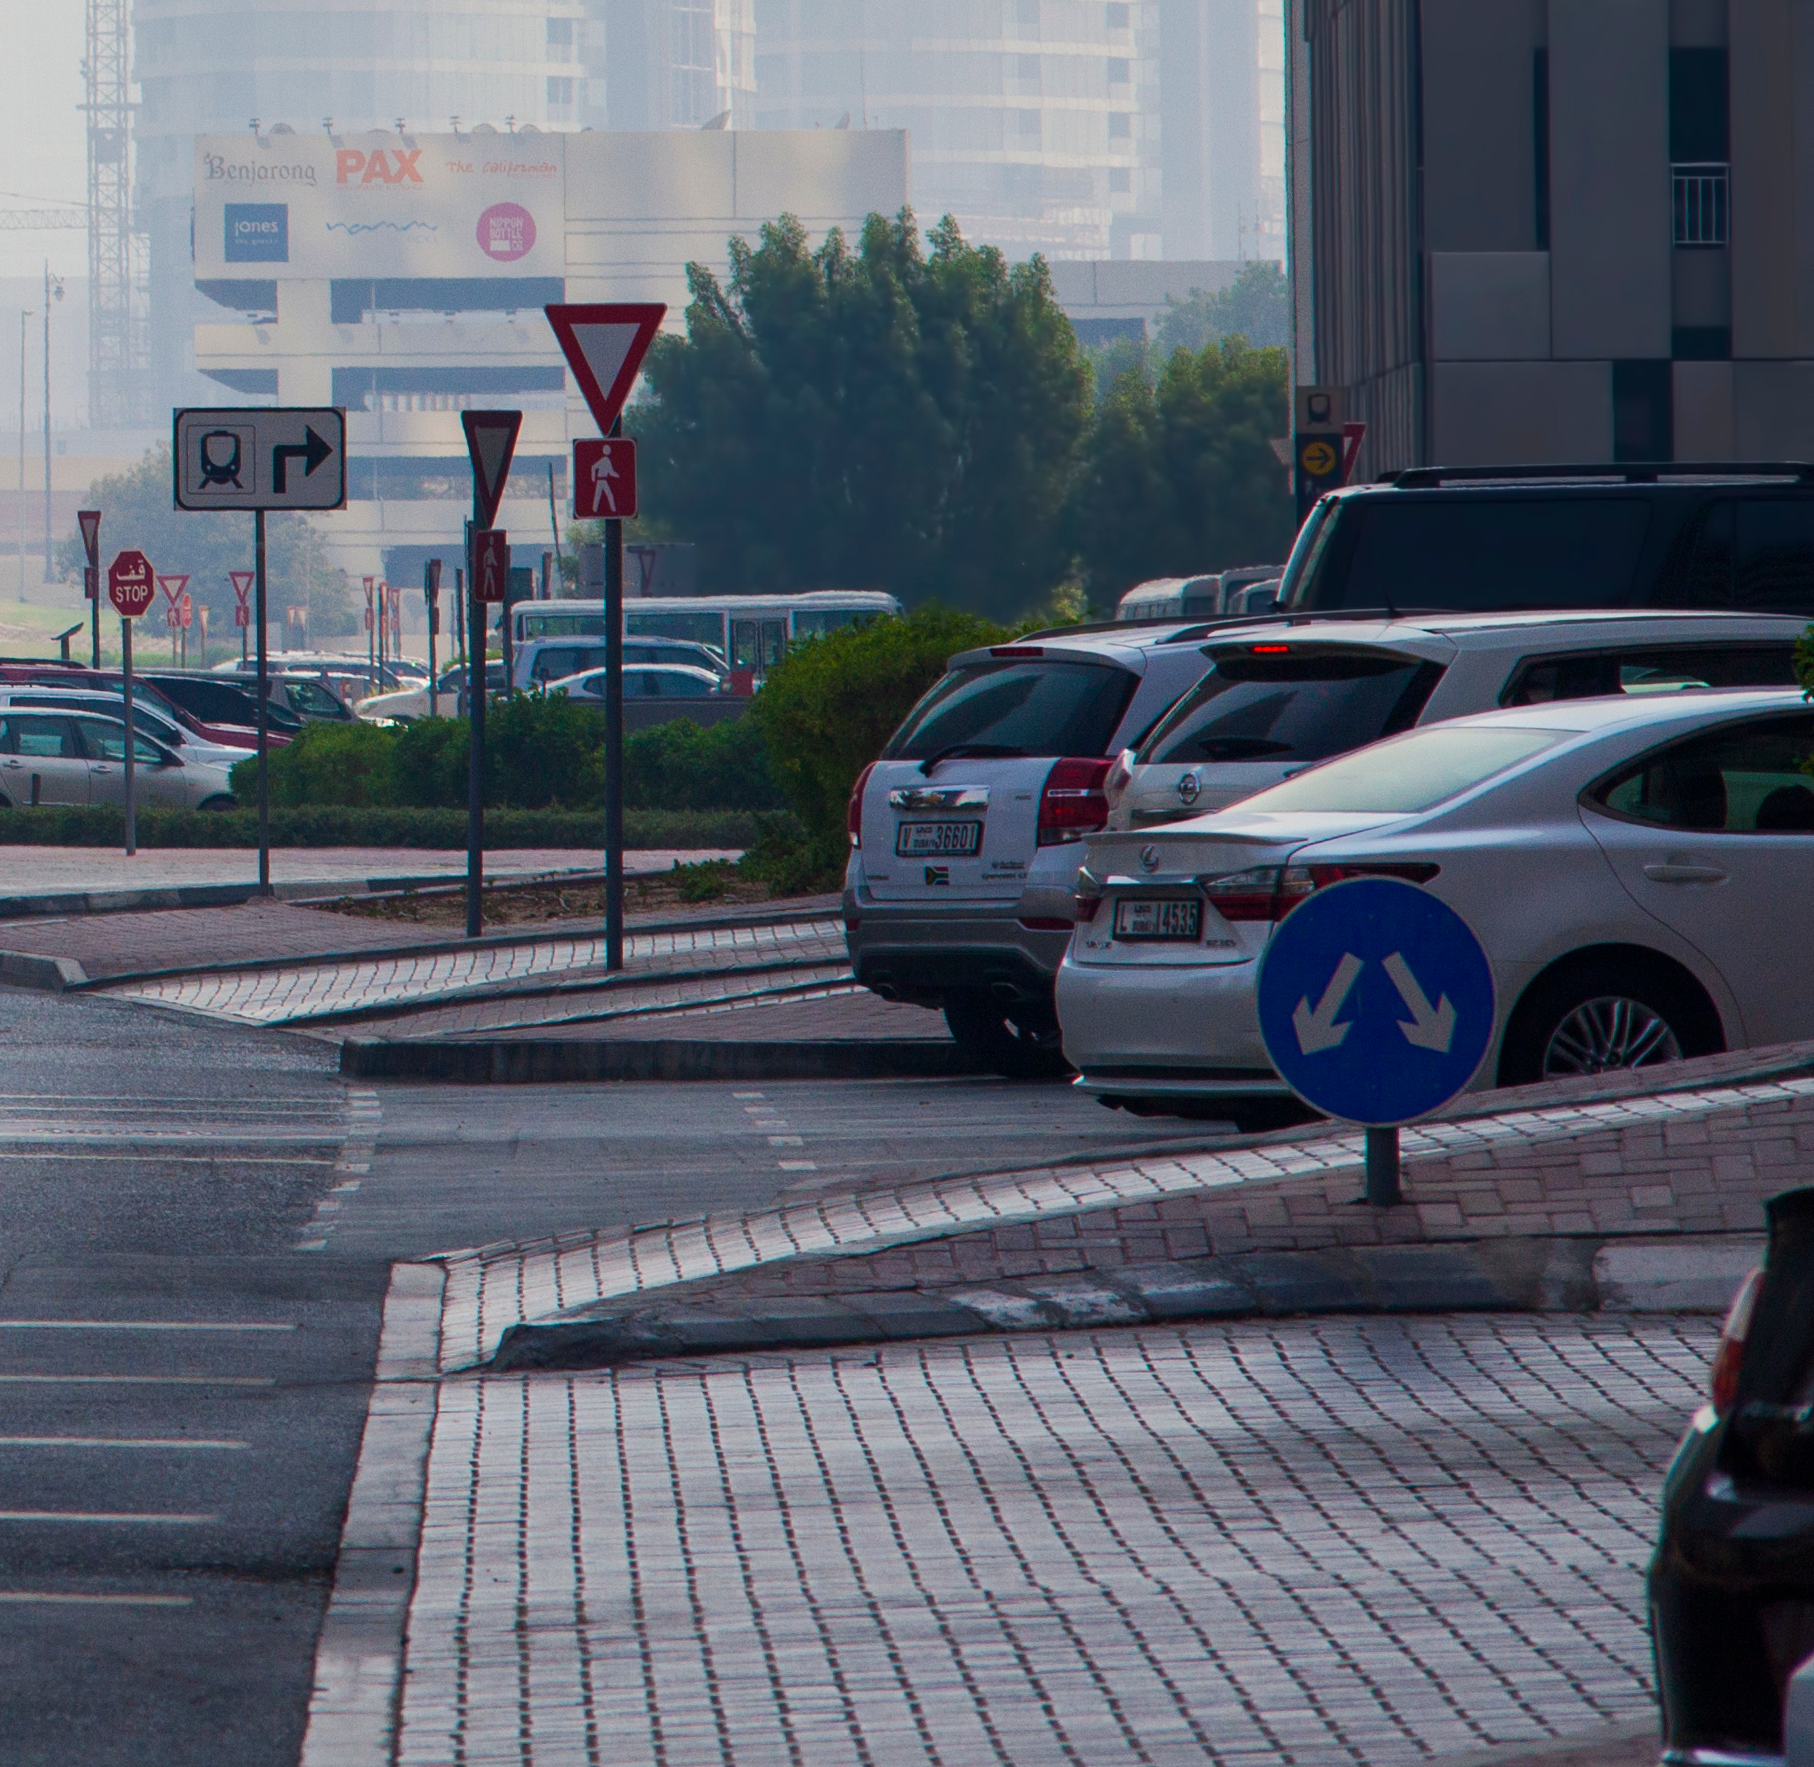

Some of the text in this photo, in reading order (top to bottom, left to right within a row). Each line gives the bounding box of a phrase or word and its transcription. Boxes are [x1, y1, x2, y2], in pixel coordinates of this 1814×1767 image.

[204, 152, 317, 186] Benjarong
[335, 149, 423, 184] PAX
[445, 160, 474, 173] The
[234, 218, 279, 237] jones
[116, 559, 146, 581] قف
[115, 585, 148, 603] STOP
[903, 824, 975, 849] V 36601
[1120, 904, 1127, 931] L
[1156, 903, 1197, 933] 14535
